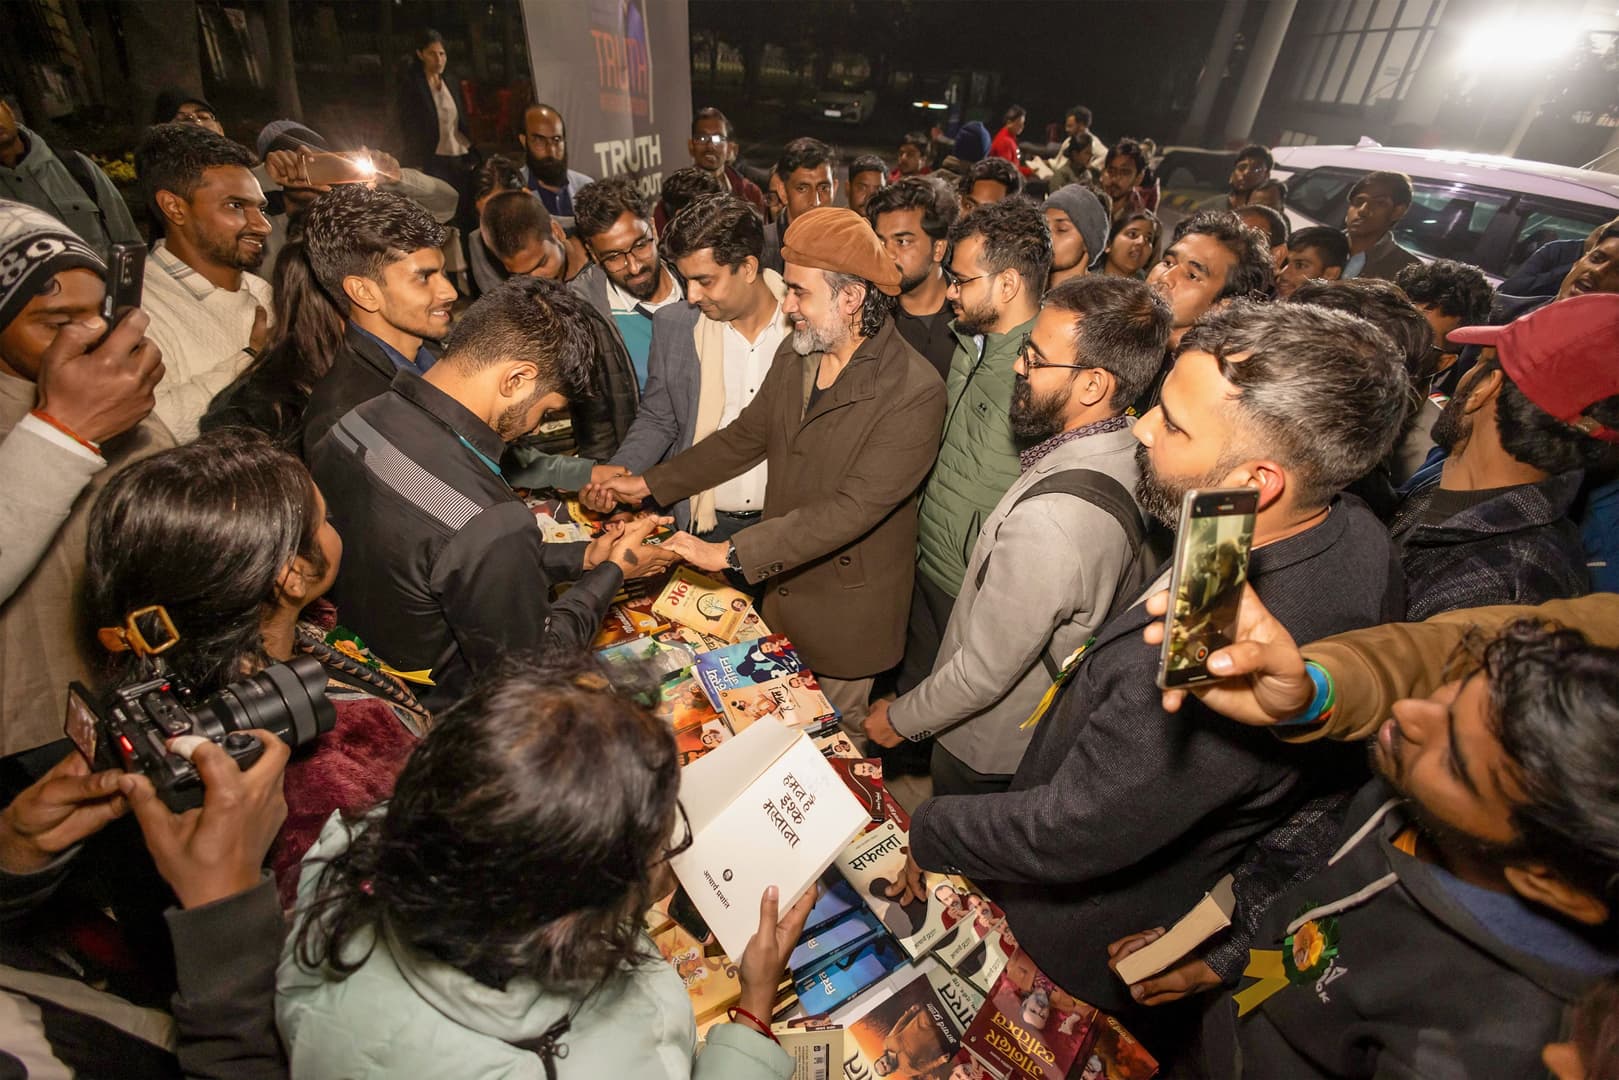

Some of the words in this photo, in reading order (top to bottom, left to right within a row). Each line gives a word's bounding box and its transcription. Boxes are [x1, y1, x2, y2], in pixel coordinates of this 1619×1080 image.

[590, 29, 649, 94] TRUTH
[594, 134, 661, 178] TRUTH
[671, 578, 689, 606] मन
[705, 668, 726, 691] हस्थ
[719, 656, 739, 686] जीवन
[783, 772, 806, 802] हमन
[762, 798, 801, 849] मस्ताना
[780, 792, 804, 825] इश्क
[848, 833, 902, 871] सफलता
[703, 869, 719, 892] आचार्य
[716, 889, 731, 910] प्रशांत
[818, 971, 836, 995] निरंत
[984, 1029, 1043, 1080] जानदार
[991, 1011, 1056, 1068] व्यक्तित्व
